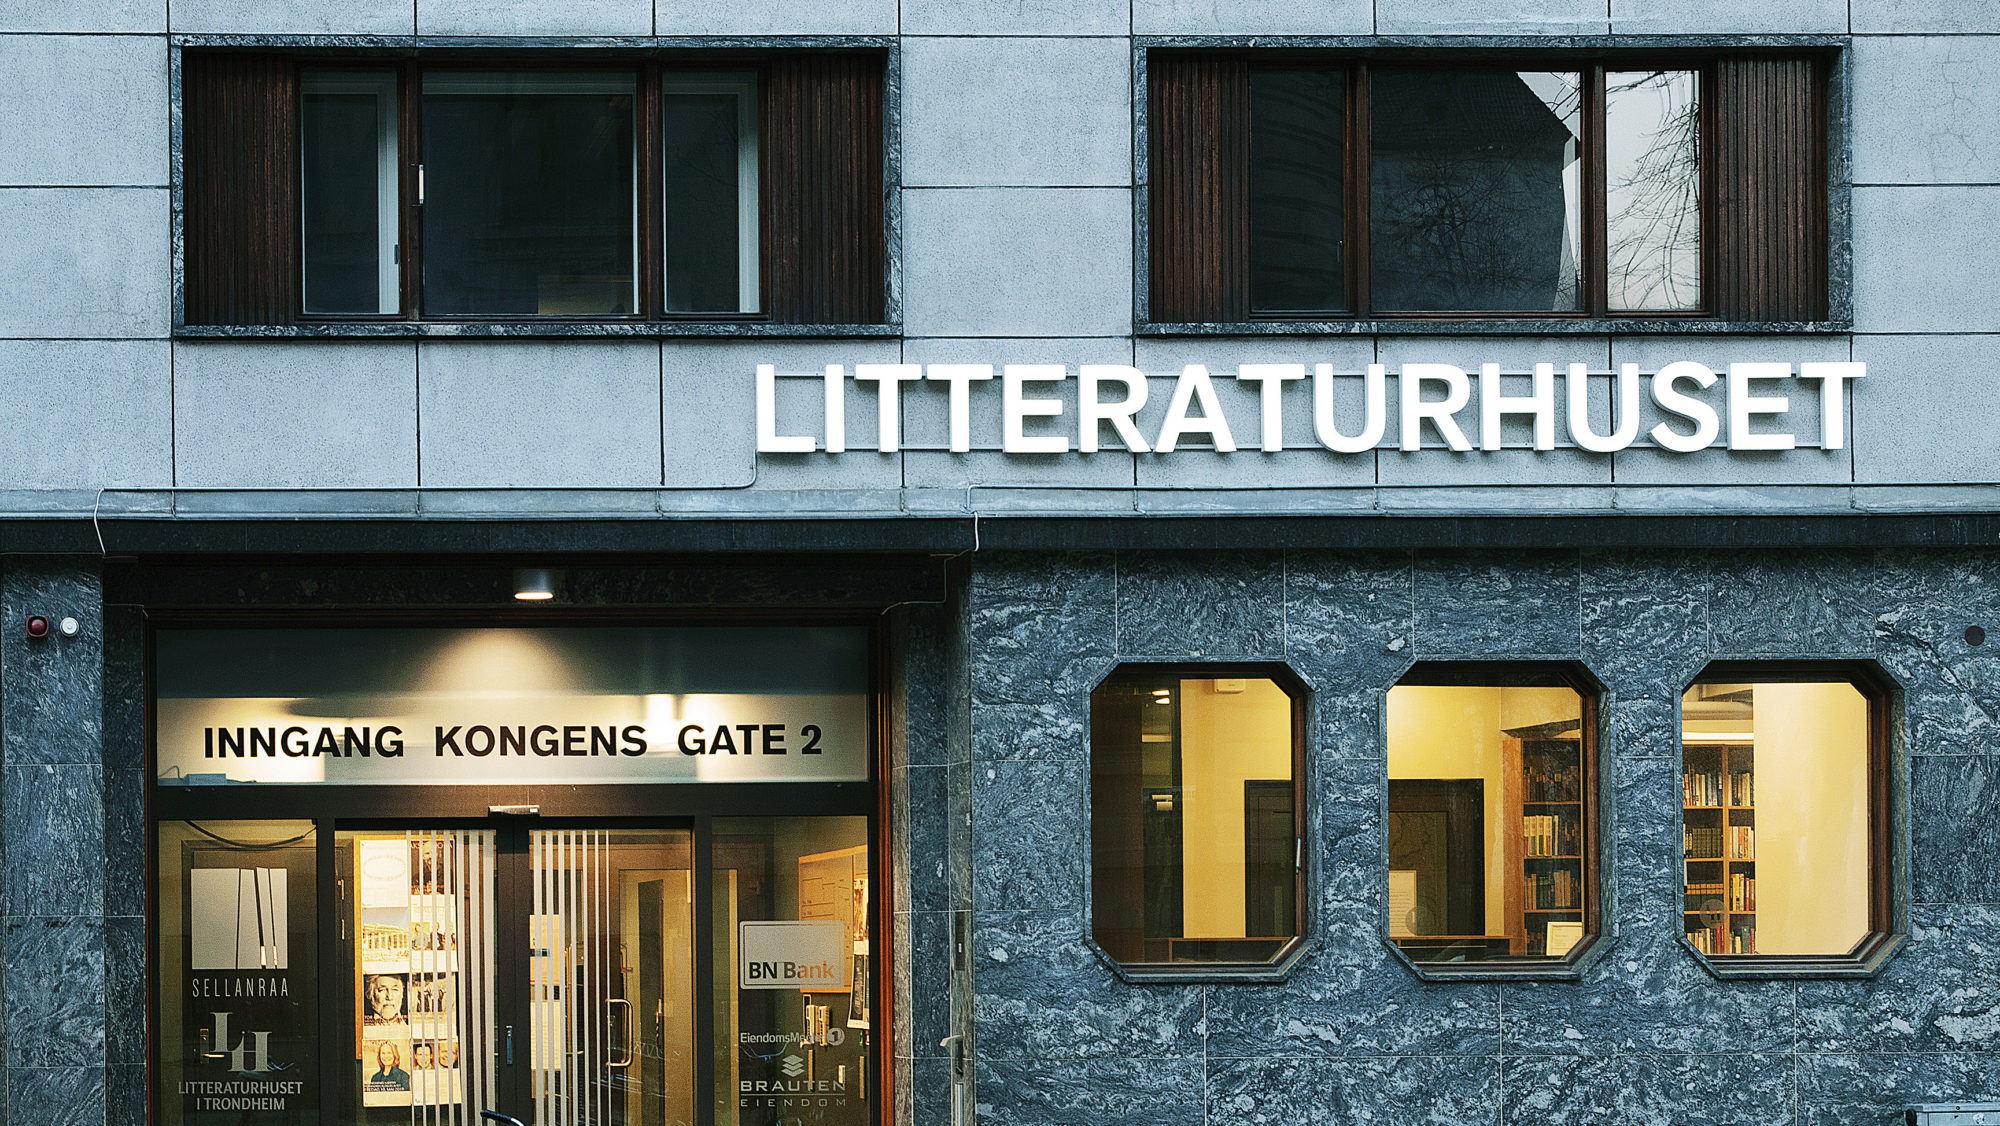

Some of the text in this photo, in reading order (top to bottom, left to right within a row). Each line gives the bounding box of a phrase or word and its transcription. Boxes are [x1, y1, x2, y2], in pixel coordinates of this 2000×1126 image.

[755, 360, 1867, 455] LITTERATURHUSET
[204, 724, 823, 758] INNGANG KONGENS GATE 2
[748, 960, 835, 979] BN Bank
[192, 977, 289, 998] SELLANRAA
[178, 1081, 304, 1095] LITTERATURHUSET
[740, 1081, 846, 1092] BRAUTEN
[197, 1097, 285, 1111] I TRONDHEIM
[740, 1098, 846, 1107] EIENDOM
